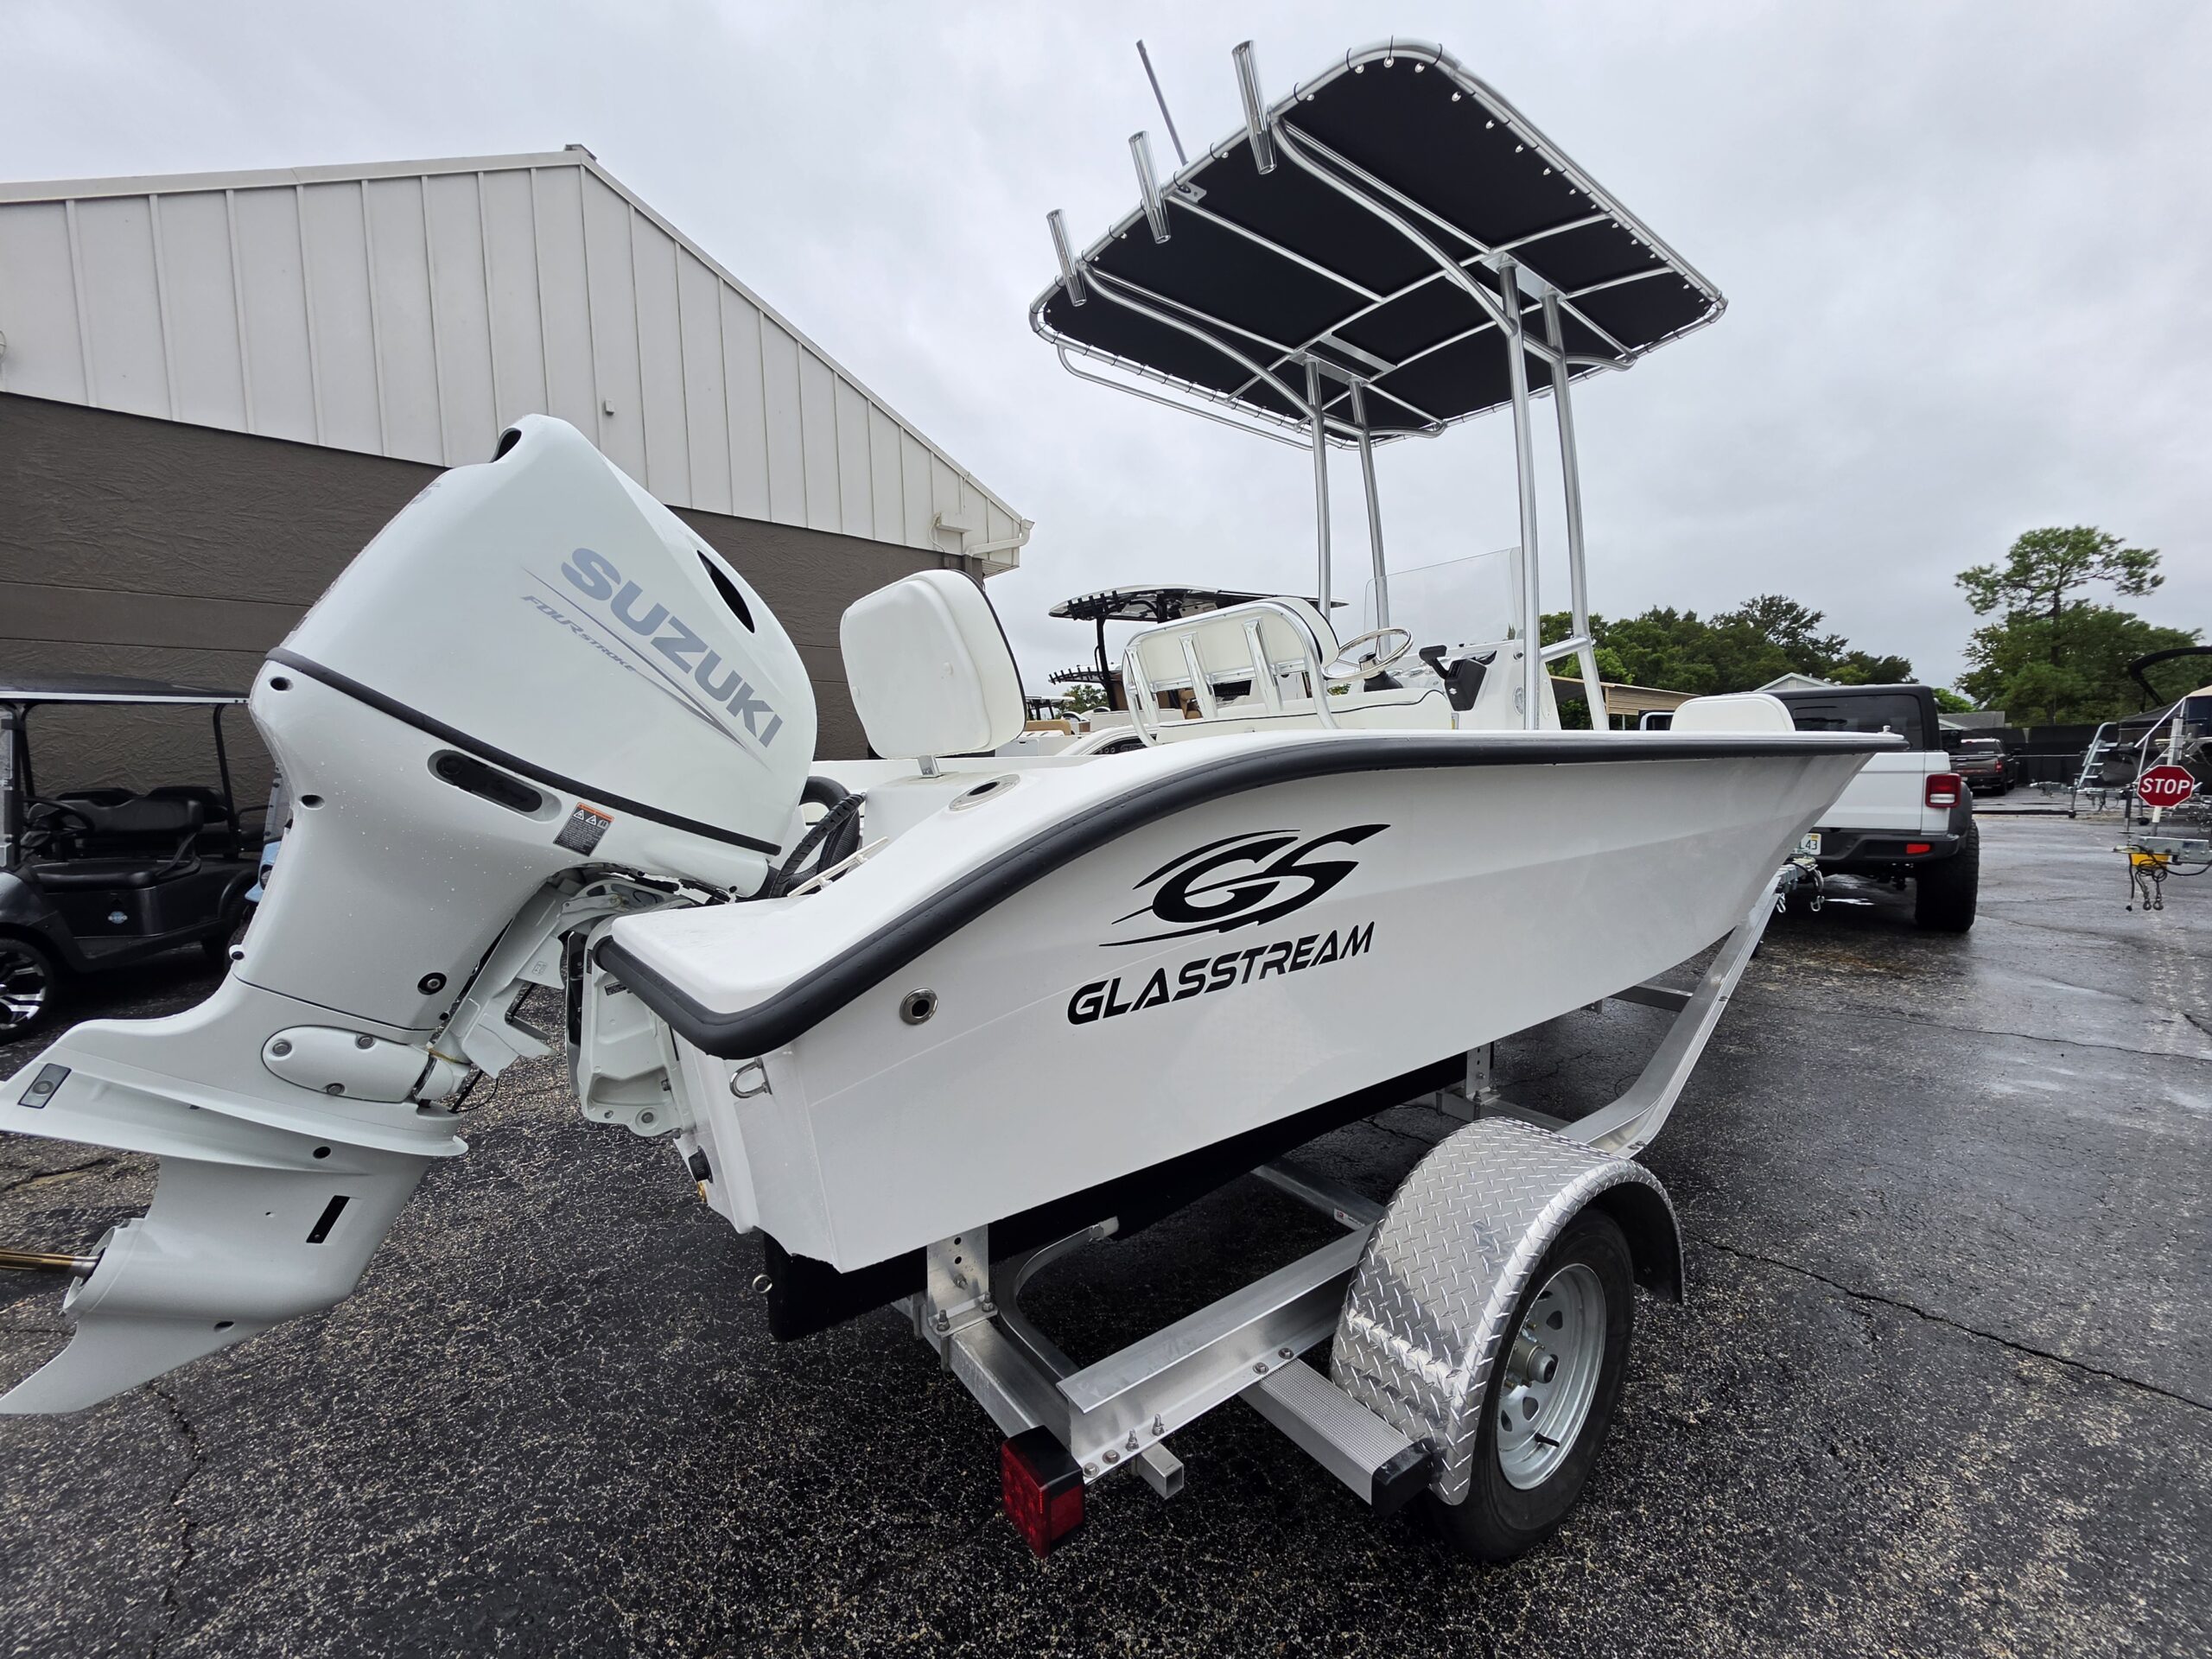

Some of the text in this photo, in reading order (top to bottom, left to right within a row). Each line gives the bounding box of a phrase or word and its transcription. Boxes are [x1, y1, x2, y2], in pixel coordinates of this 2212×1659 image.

[561, 547, 783, 748] SUZUKI
[2140, 778, 2190, 795] STOP
[1130, 823, 1391, 933] GS
[1067, 921, 1375, 1026] GLASSTREAM
